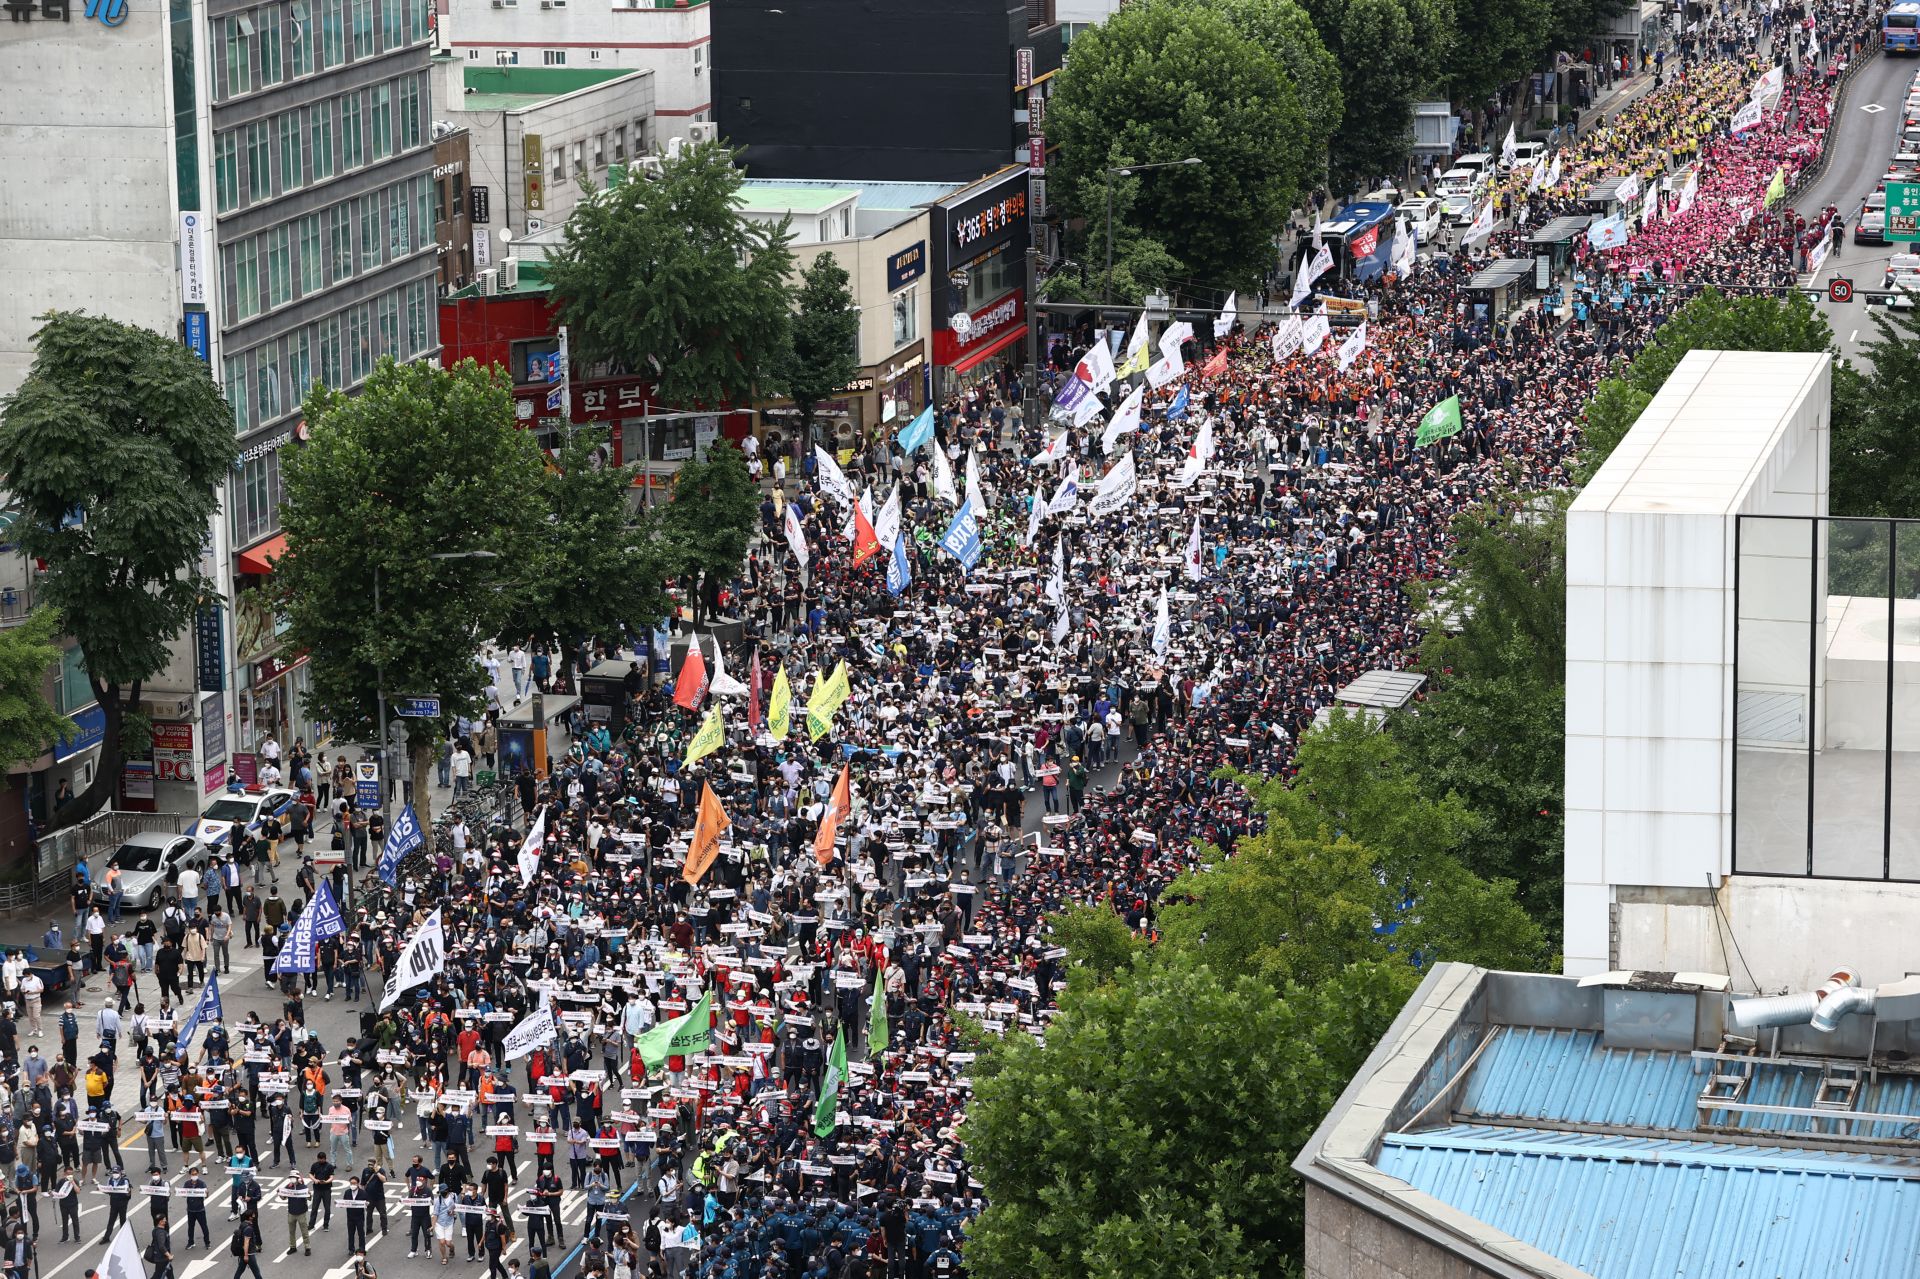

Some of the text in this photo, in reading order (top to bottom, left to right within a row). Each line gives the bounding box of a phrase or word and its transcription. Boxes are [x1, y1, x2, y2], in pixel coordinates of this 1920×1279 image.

[1903, 187, 1920, 196] 흥인
[967, 190, 1025, 243] 365광덕안정한의원
[187, 228, 198, 300] 더조은컴퓨터아카데미
[1834, 285, 1847, 296] 50
[158, 760, 192, 780] PC
